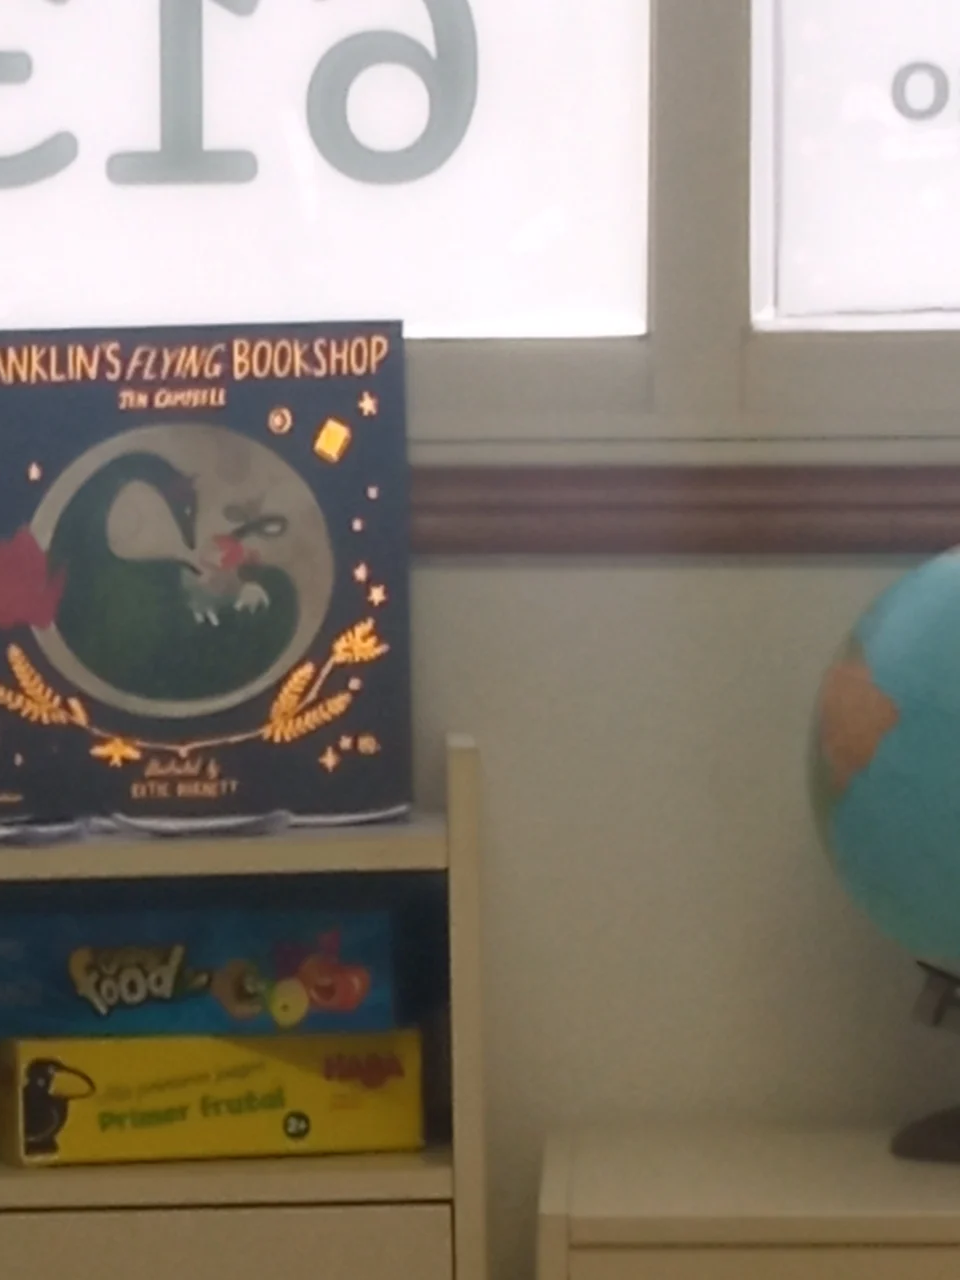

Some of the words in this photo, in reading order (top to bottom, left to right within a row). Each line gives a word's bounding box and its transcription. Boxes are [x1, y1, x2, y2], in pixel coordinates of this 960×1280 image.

[125, 343, 225, 381] FLYING
[232, 335, 388, 381] BOOKSHOP
[98, 1105, 189, 1133] Primer
